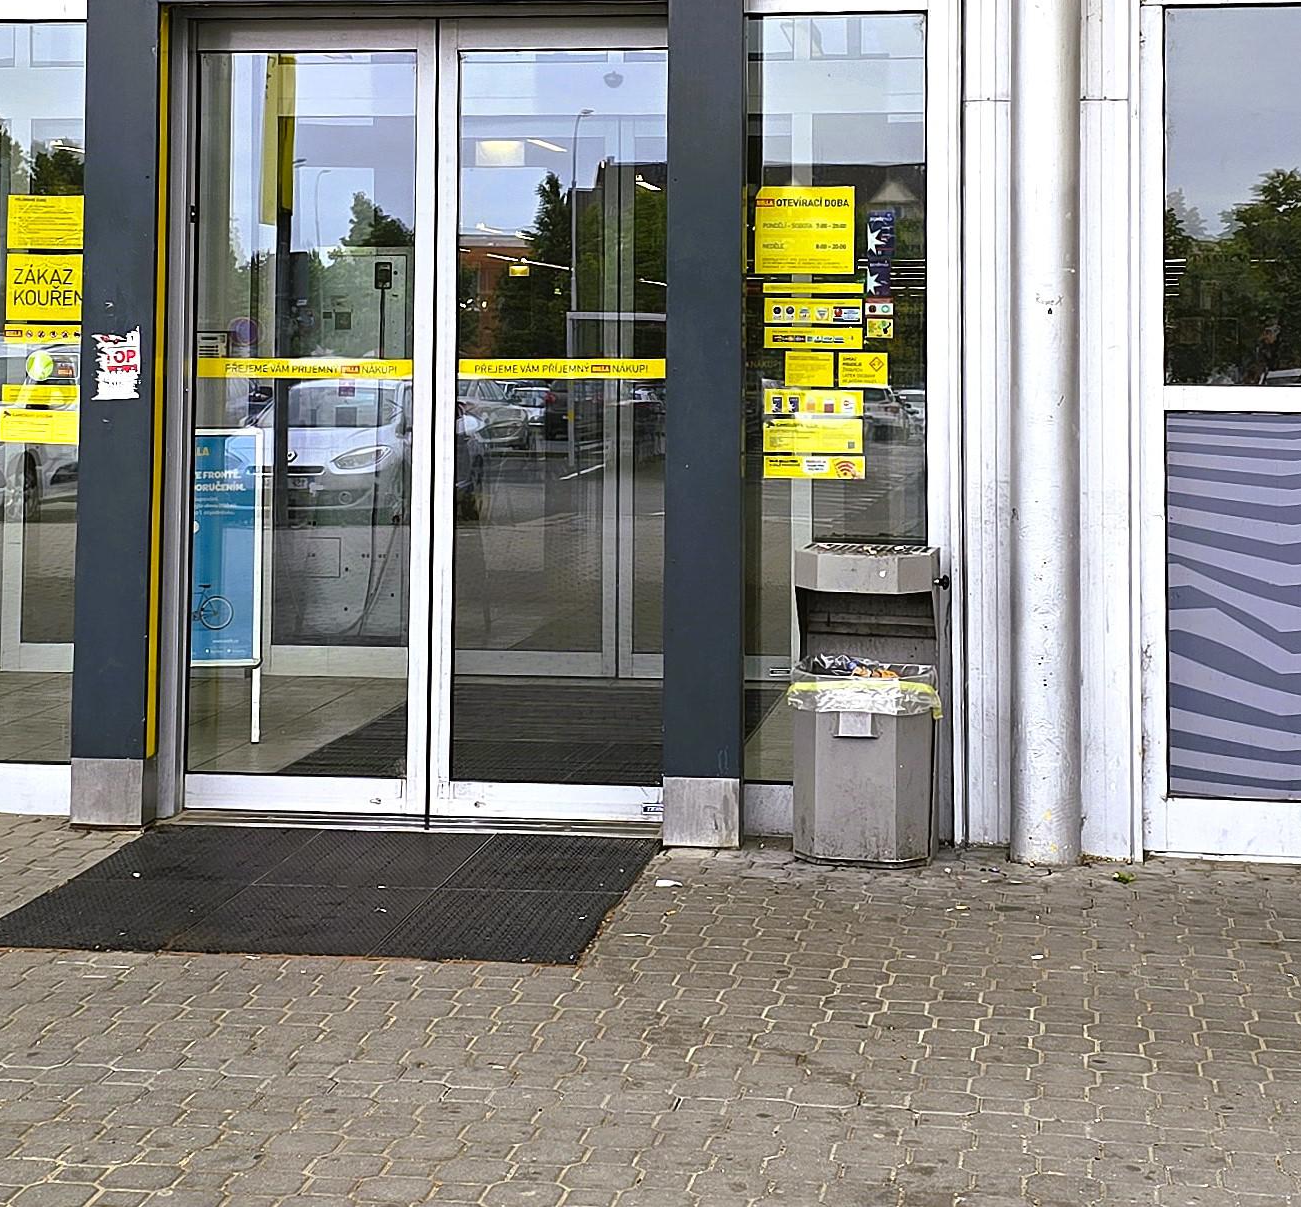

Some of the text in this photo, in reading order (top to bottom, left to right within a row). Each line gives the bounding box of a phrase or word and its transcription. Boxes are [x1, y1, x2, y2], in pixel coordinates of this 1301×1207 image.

[776, 197, 822, 207] OTEVÍRACÍ
[824, 199, 849, 207] DOBA
[13, 264, 73, 285] ZÁKAZ
[107, 349, 136, 364] OP
[225, 363, 268, 373] PŘEJEME
[270, 363, 290, 373] VÁM
[474, 364, 518, 373] PŘEJEME
[520, 364, 540, 373] VÁM
[542, 364, 589, 373] PŘÍJEMNÝ
[612, 364, 648, 373] NÁKUP!
